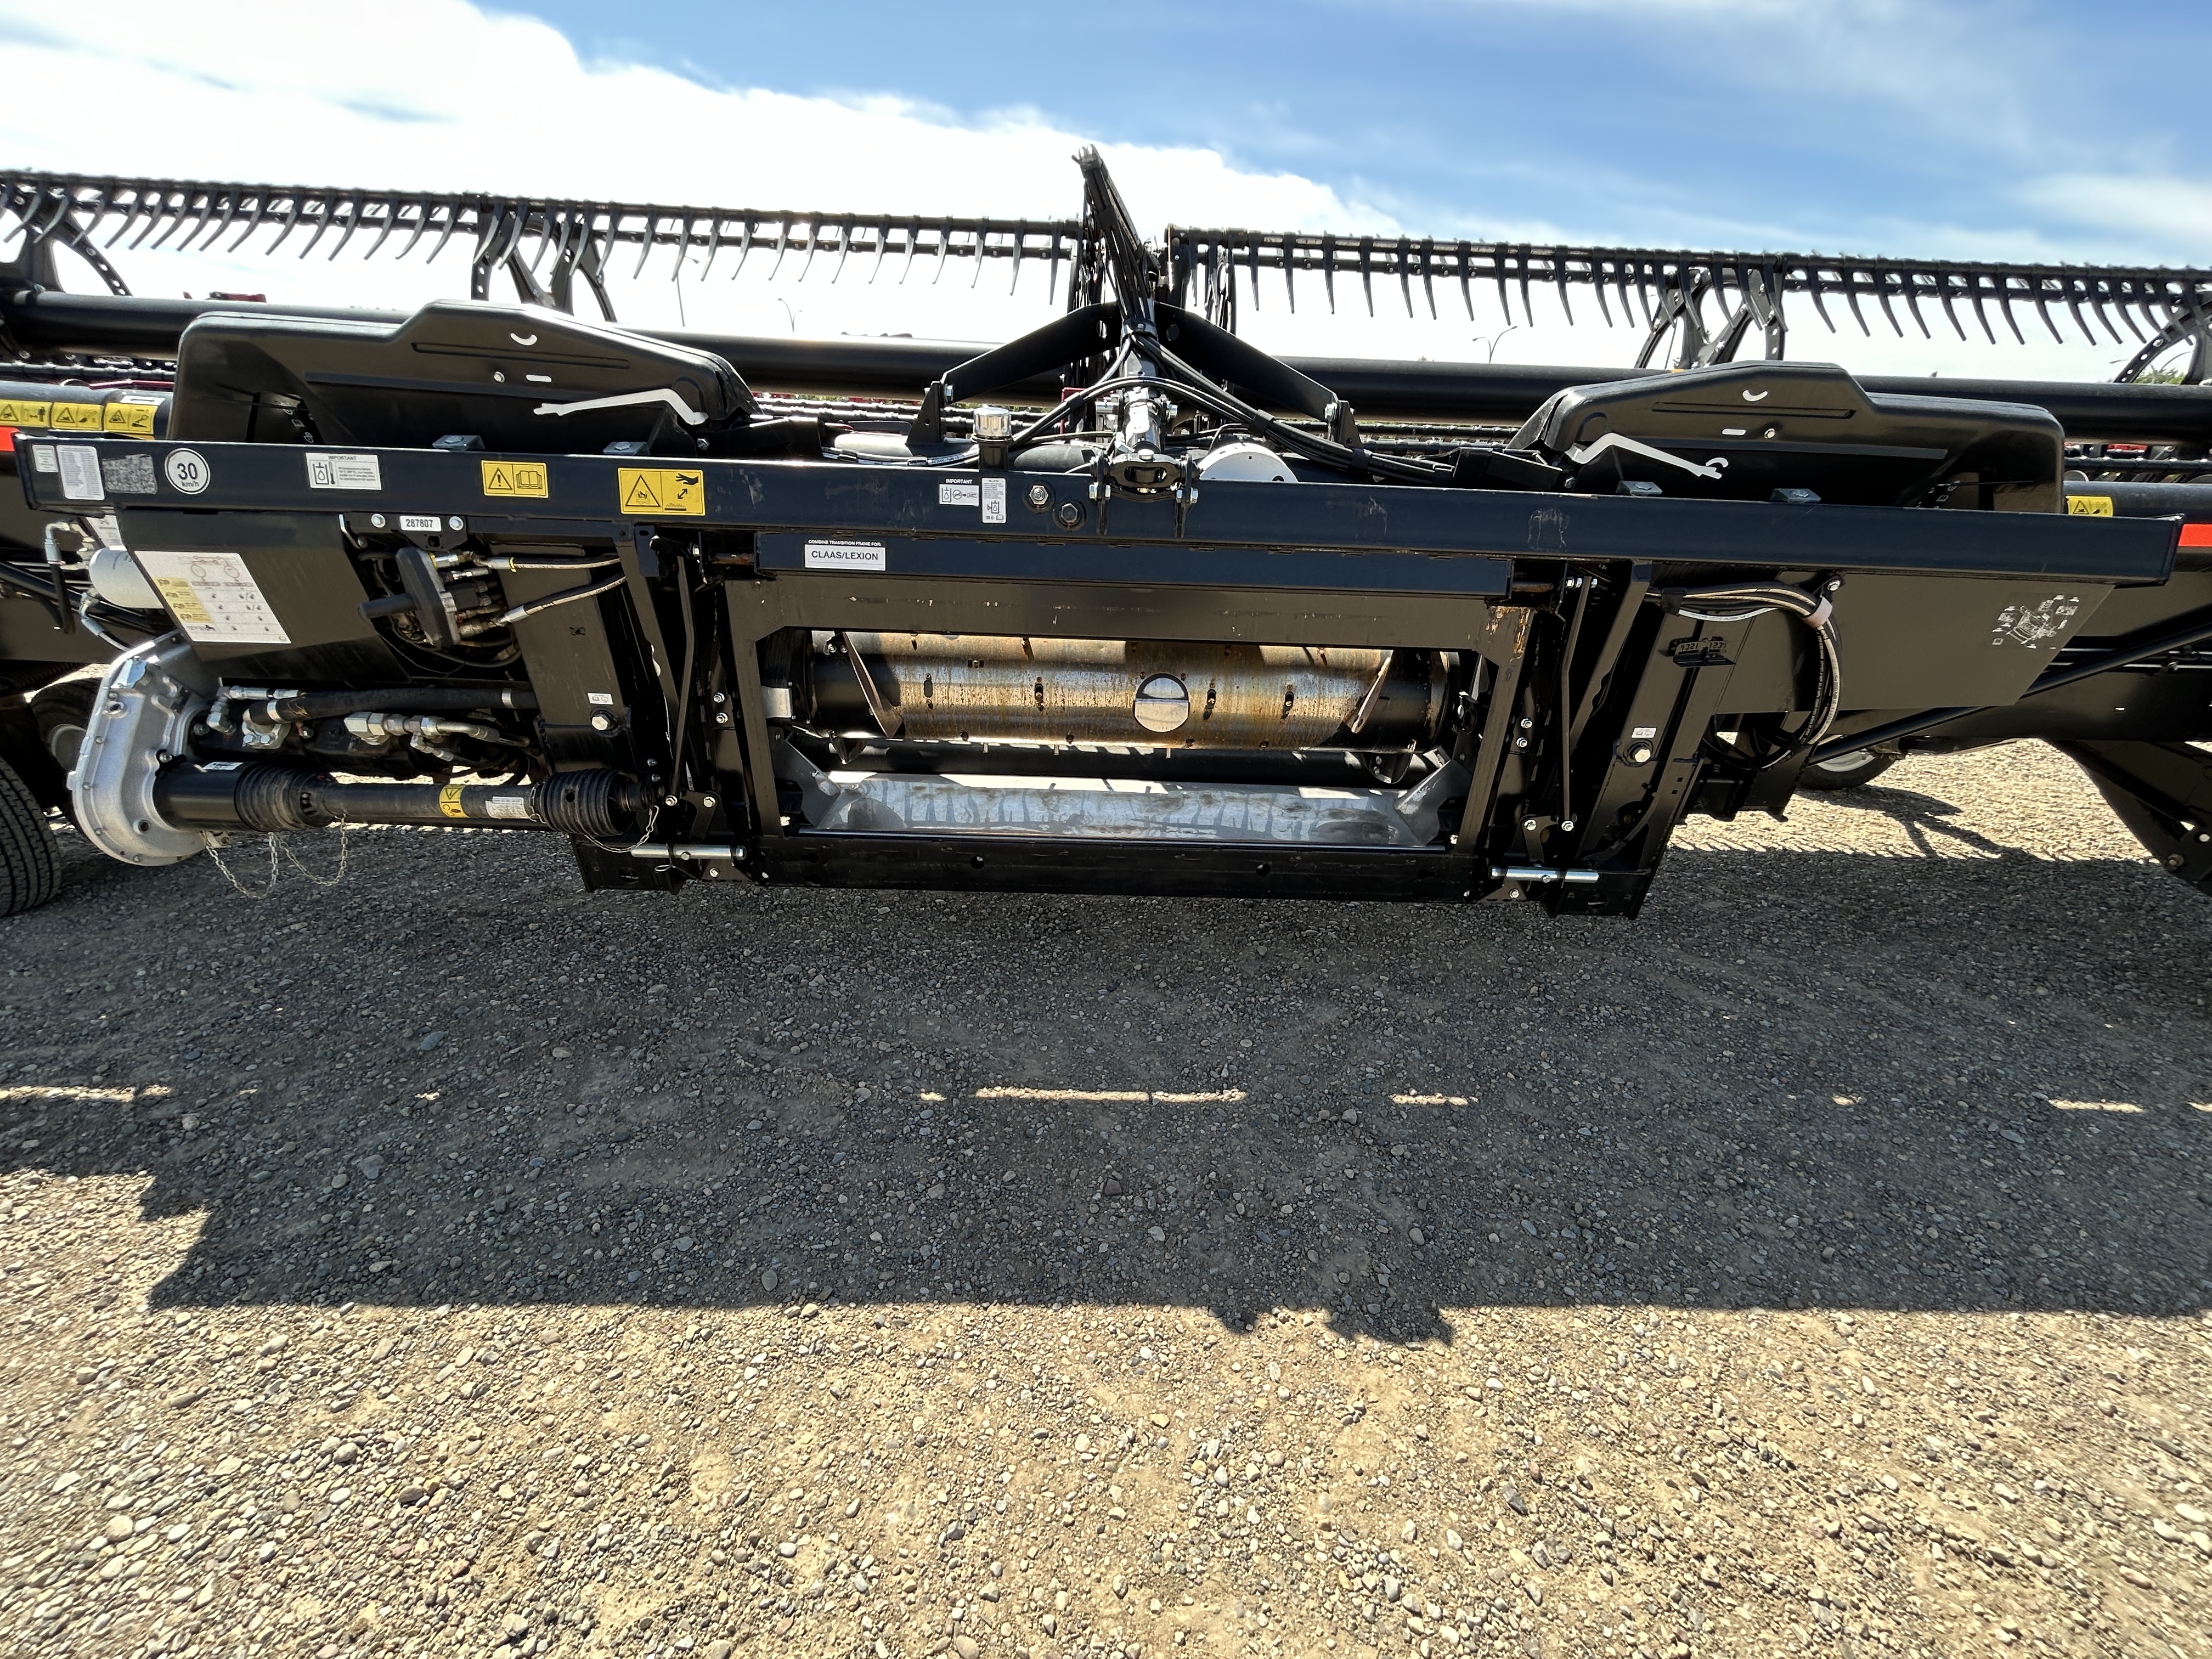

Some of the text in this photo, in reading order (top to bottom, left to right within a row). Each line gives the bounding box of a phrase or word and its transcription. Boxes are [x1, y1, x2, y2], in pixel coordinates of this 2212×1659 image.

[177, 462, 198, 480] 30
[405, 518, 433, 528] 287807
[811, 551, 878, 560] CLAAS/LEXION
